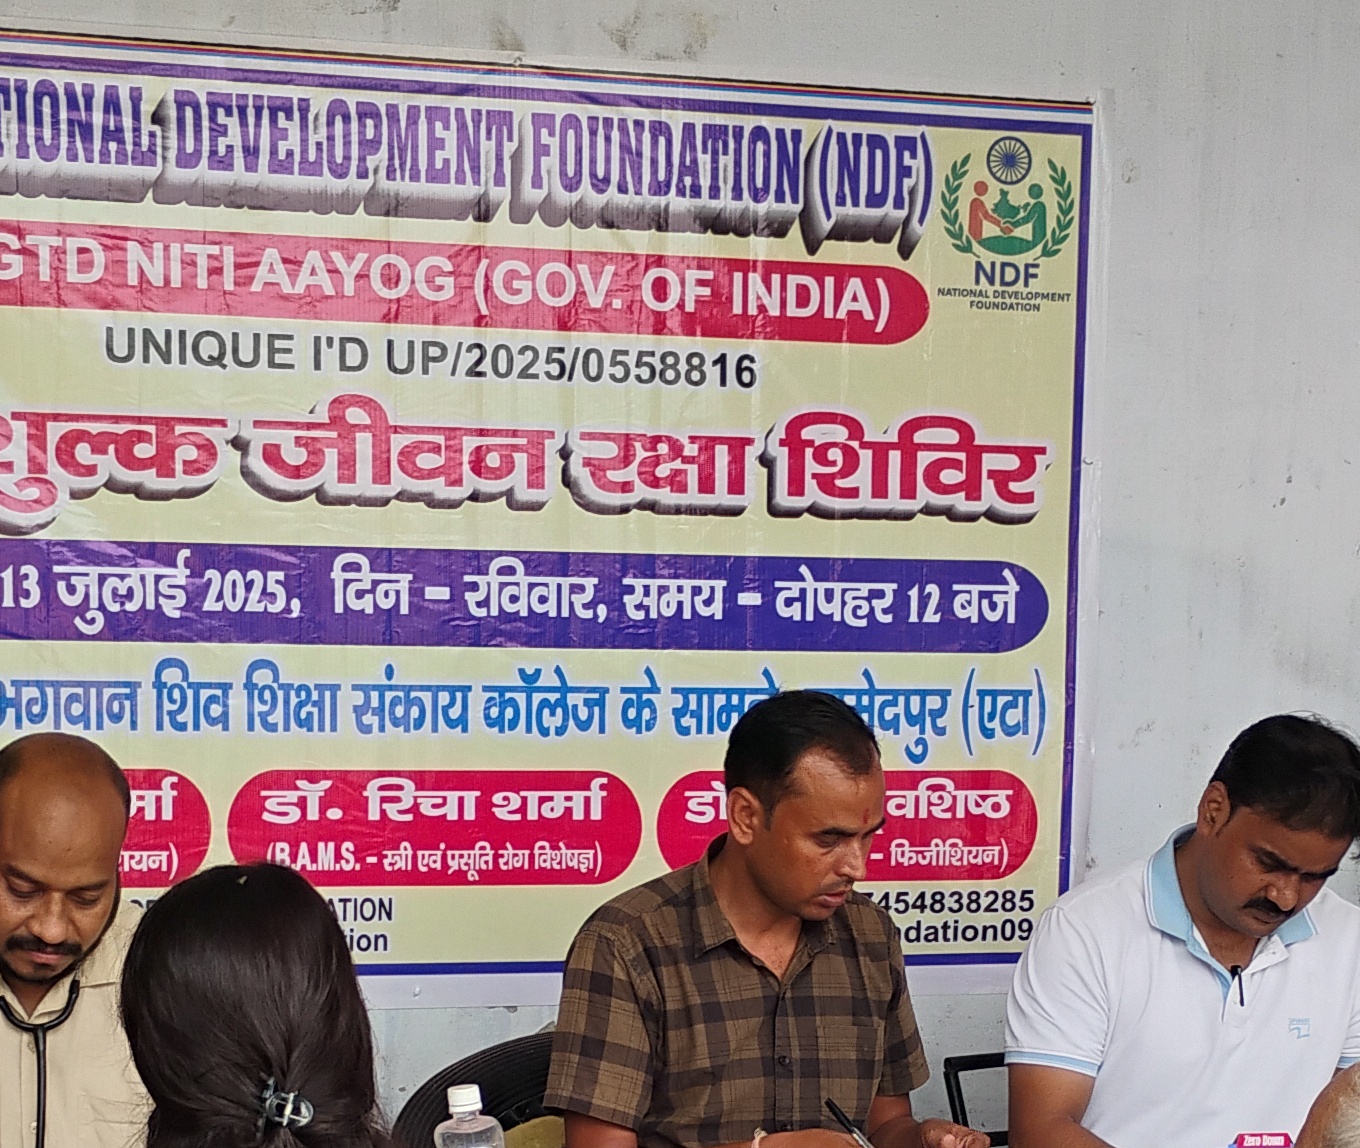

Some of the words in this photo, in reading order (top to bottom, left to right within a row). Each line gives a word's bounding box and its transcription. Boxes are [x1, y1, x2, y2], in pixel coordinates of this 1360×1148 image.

[174, 89, 514, 189] DEVELOPMENT
[530, 112, 804, 205] FOUNDATION
[819, 122, 932, 227] (NDF)
[127, 240, 234, 290] NITI
[251, 247, 455, 301] AAYOG
[474, 258, 623, 316] (GOV.
[641, 266, 713, 314] OF
[733, 272, 891, 333] INDIA)
[937, 287, 990, 299] NATIONAL
[992, 290, 1071, 303] DEVELOPMENT
[974, 260, 1040, 288] NDF
[969, 300, 1040, 312] FOUNDATION
[106, 326, 295, 371] UNIQUE
[313, 334, 369, 372] I'D
[386, 339, 758, 389] UP/2025/0558816
[253, 394, 553, 490] जीवन
[581, 432, 755, 496] रक्षा
[779, 412, 1047, 504] शिविर
[0, 565, 39, 609] 13
[53, 548, 192, 634] जुलाई
[203, 568, 301, 618] 2025,
[331, 553, 412, 615] दिन
[464, 557, 608, 623] रविवार,
[623, 577, 726, 621] समय
[774, 565, 897, 627] दोपहर
[909, 584, 941, 624] 12
[952, 569, 1019, 624] बजे
[152, 657, 231, 733] शिव
[244, 658, 341, 733] शिक्षा
[352, 663, 472, 737] संकाय
[482, 665, 609, 738] कॉलेज
[620, 666, 661, 737] के
[962, 667, 1046, 757] (एटा)
[260, 779, 344, 824] डॉ.
[362, 777, 481, 821] रिचा
[491, 777, 608, 821] शर्मा
[885, 777, 1014, 819] वशिष्ठ
[266, 841, 361, 872] (B.A.M.S.
[382, 841, 412, 871] स्त्री
[417, 842, 445, 871] एवं
[446, 840, 494, 881] प्रसूति
[498, 841, 529, 870] रोग
[534, 840, 602, 877] विशेषज्ञ)
[889, 837, 1009, 873] फिजीशियन)
[1242, 1134, 1261, 1147] Zero
